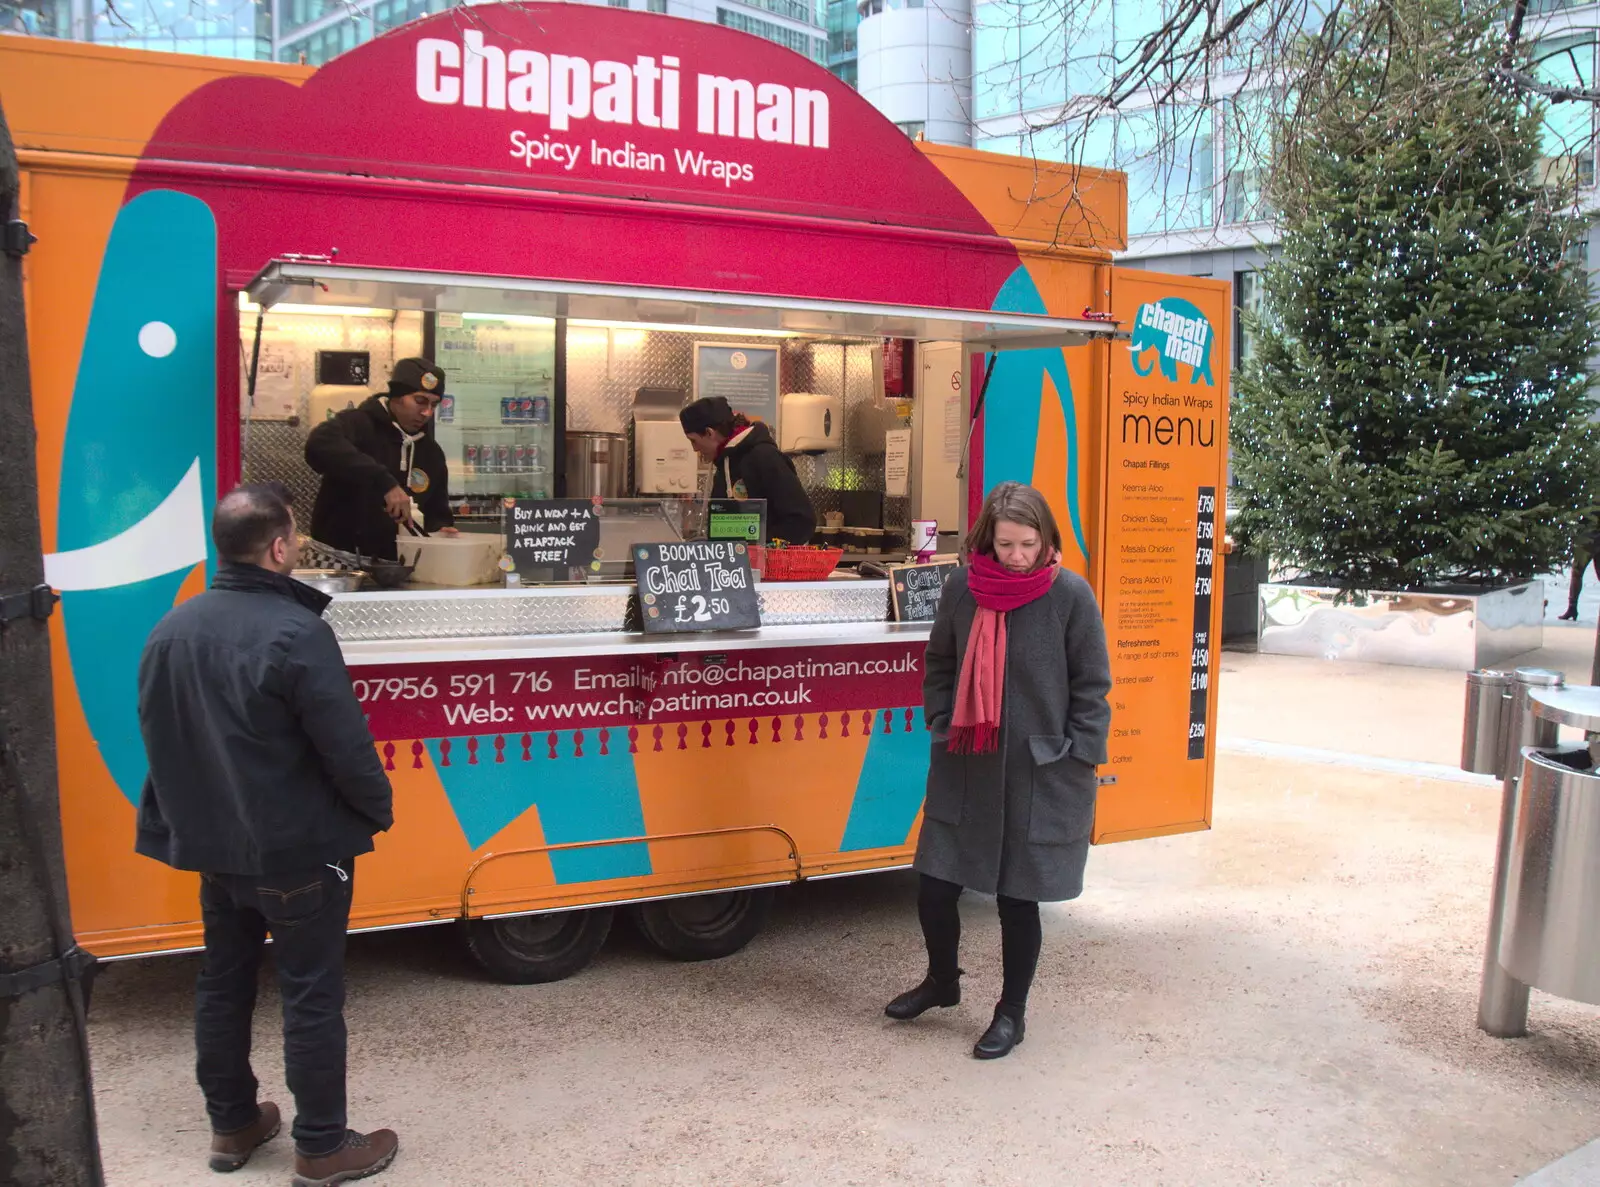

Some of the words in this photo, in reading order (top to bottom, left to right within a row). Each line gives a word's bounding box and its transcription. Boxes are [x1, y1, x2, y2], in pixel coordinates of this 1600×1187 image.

[416, 29, 680, 131] chapati
[697, 73, 830, 149] man
[509, 130, 581, 171] Spicy
[591, 139, 665, 173] Indian
[674, 148, 754, 187] Wraps
[1141, 302, 1209, 346] chapati
[1164, 333, 1204, 368] man
[1123, 391, 1149, 408] Spicy
[1152, 393, 1180, 406] Indian
[1183, 395, 1213, 411] Wraps
[1122, 413, 1214, 448] menu
[1122, 459, 1147, 470] Chapati
[1149, 460, 1170, 470] Fillings
[514, 507, 533, 520] BUY
[534, 509, 542, 519] A
[582, 509, 591, 519] A
[1121, 514, 1148, 523] Chicken
[514, 523, 545, 535] DRINK
[547, 522, 567, 532] AND
[569, 522, 587, 532] GET
[514, 538, 522, 548] A
[523, 535, 576, 548] FLAPJACK
[1120, 544, 1146, 553] Masala
[646, 562, 702, 595] Chai
[704, 561, 747, 592] Tea
[906, 566, 942, 590] Card
[1117, 639, 1160, 648] Refreshments
[352, 676, 439, 702] 07956
[449, 673, 495, 697] 591
[510, 670, 553, 694] 716
[660, 651, 919, 688] nfo@chapatiman.co.uk
[442, 699, 515, 726] Web:
